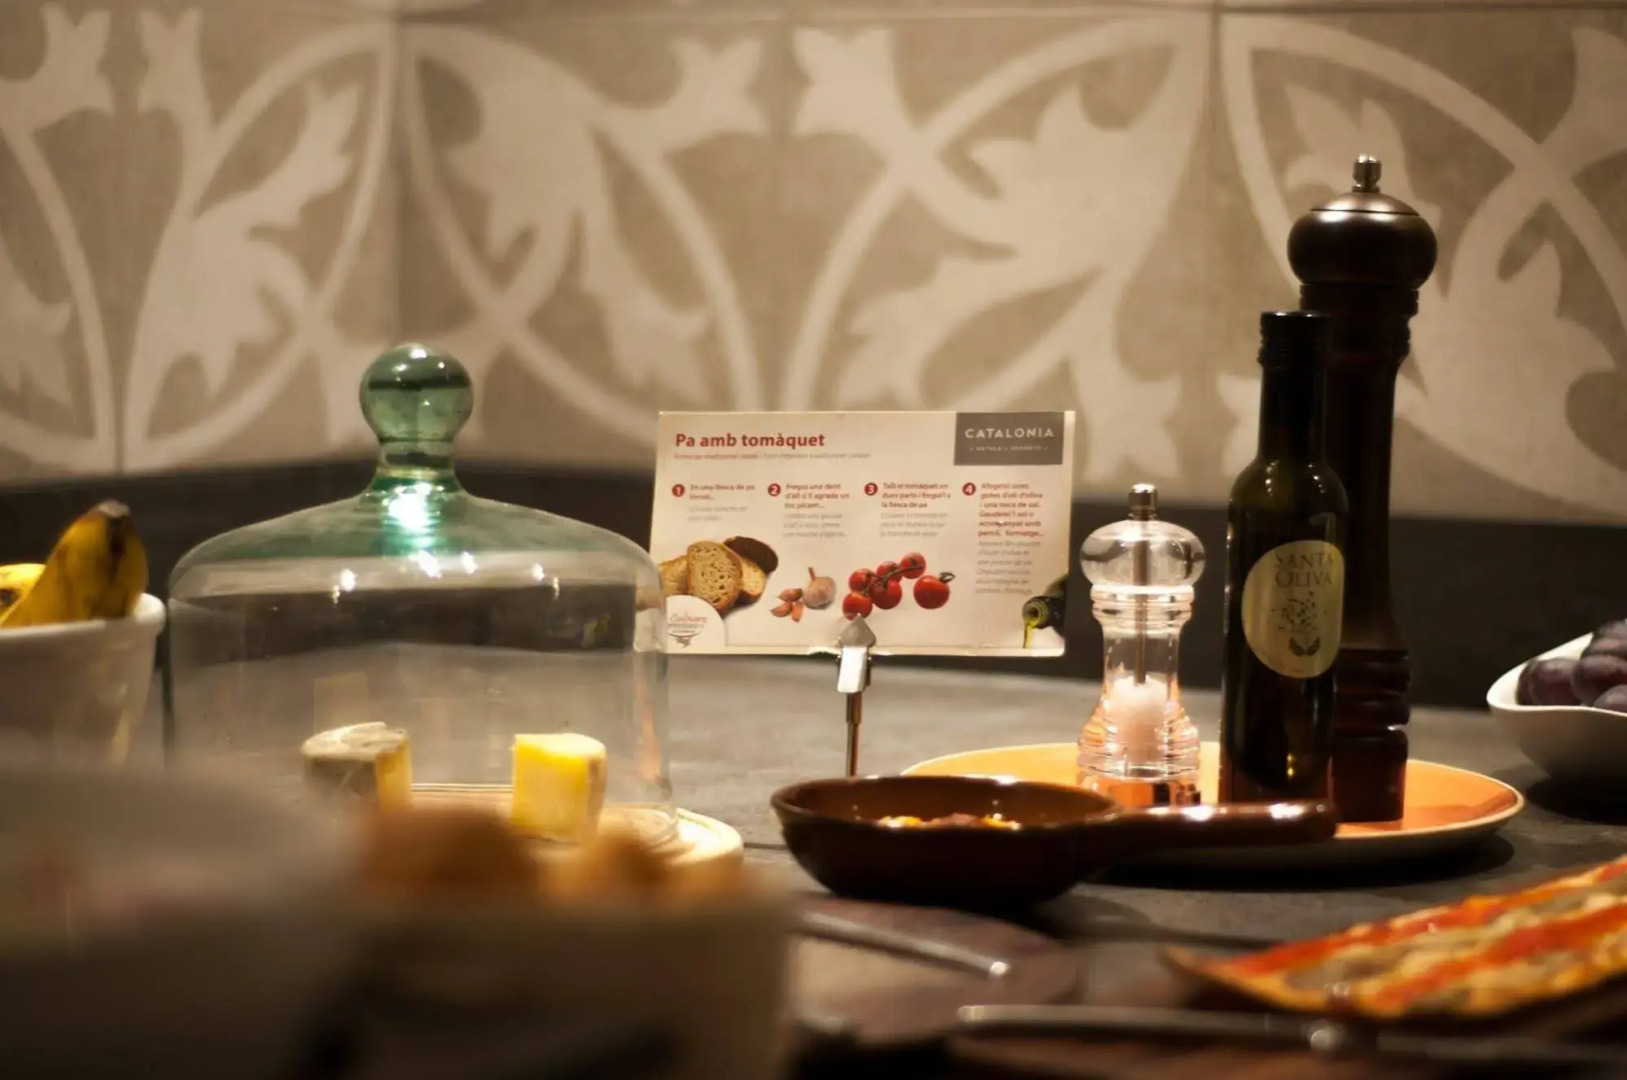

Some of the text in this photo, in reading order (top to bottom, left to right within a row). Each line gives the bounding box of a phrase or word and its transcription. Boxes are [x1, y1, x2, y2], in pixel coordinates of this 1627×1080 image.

[676, 433, 825, 450] Pa amb tomàquet
[964, 428, 1055, 439] CATALONIA
[1275, 552, 1334, 568] SANTA
[1275, 571, 1332, 587] OLIVA
